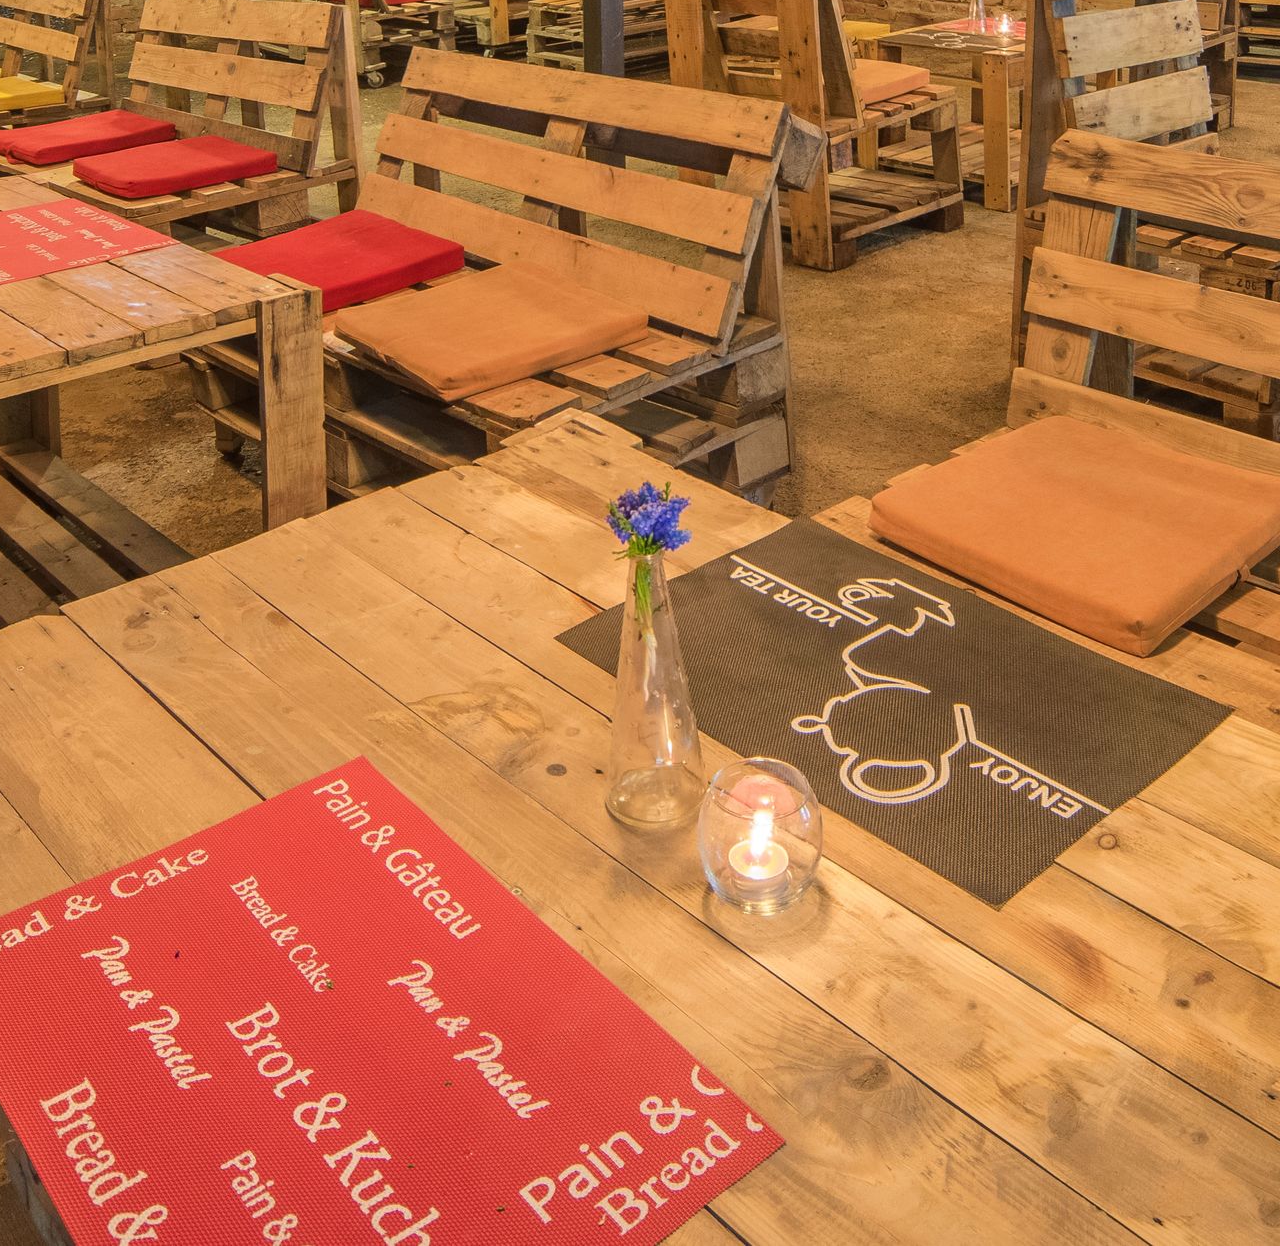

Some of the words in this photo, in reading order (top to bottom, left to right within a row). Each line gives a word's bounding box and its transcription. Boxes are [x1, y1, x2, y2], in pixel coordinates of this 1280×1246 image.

[729, 566, 776, 595] TEA
[772, 589, 842, 628] YOUR
[969, 757, 1083, 819] ENJOY
[64, 895, 102, 922] &
[110, 848, 209, 899] Cake
[313, 778, 371, 830] Pain
[360, 824, 396, 853] &
[385, 848, 481, 939] Gâteau
[81, 935, 131, 989] Pan
[230, 876, 280, 928] Bread
[270, 926, 299, 947] &
[288, 944, 333, 994] Cake
[120, 988, 153, 1010] &
[388, 959, 443, 1014] Pan
[436, 1016, 470, 1038] &
[455, 1032, 554, 1120] Pastel
[129, 1005, 212, 1090] Pastel
[226, 1002, 313, 1099] Brot
[293, 1092, 347, 1143] &
[40, 1078, 148, 1206] Bread
[221, 1150, 276, 1218] Pain
[519, 1131, 643, 1224] Pain
[639, 1095, 696, 1136] &
[596, 1118, 741, 1235] Bread
